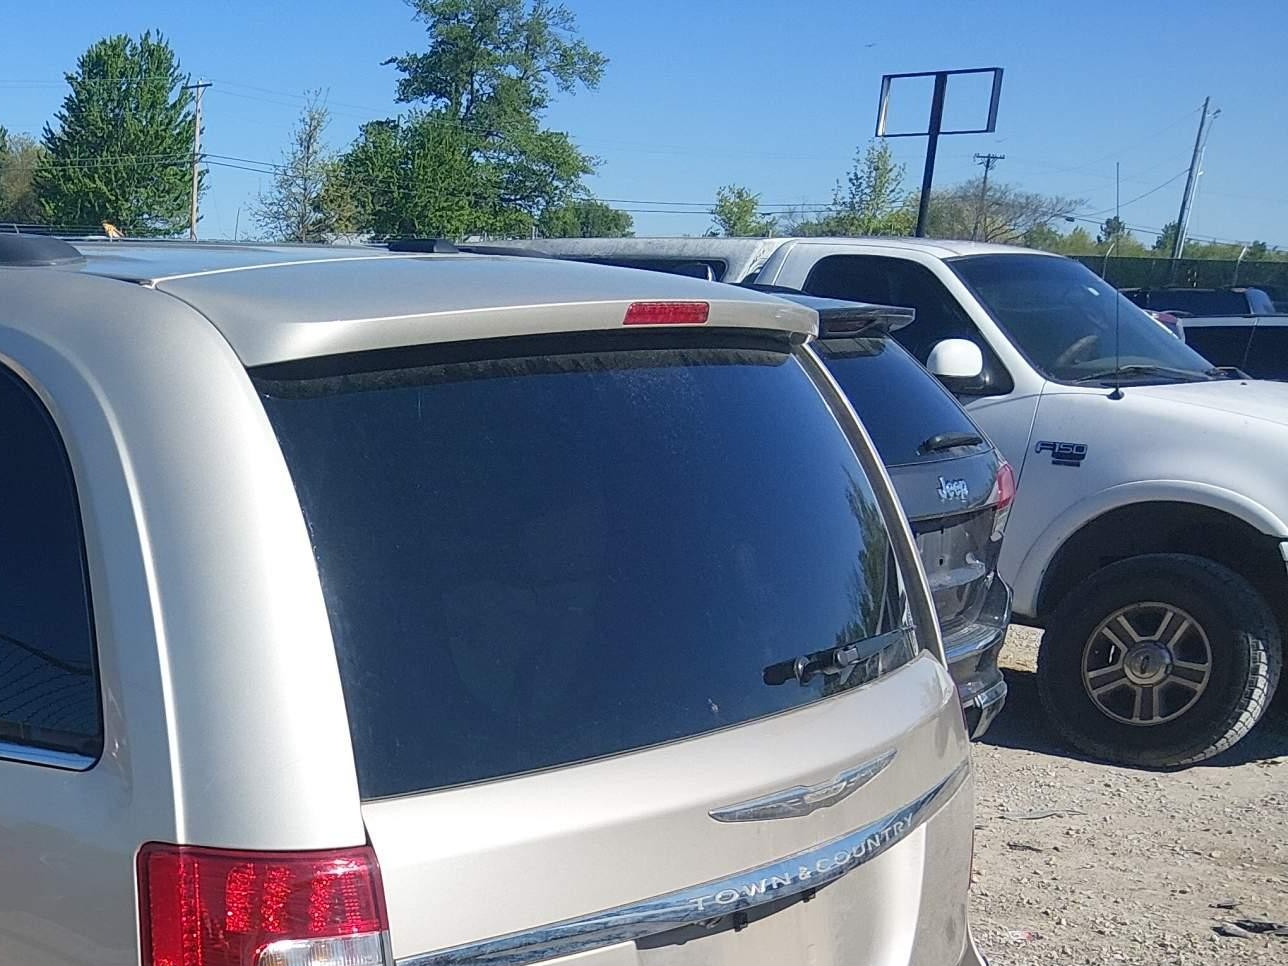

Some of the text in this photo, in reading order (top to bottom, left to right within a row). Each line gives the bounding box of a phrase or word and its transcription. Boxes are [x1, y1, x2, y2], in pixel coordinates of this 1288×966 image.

[937, 476, 969, 503] Jeep
[688, 812, 914, 911] TOWN & COUNTRY
